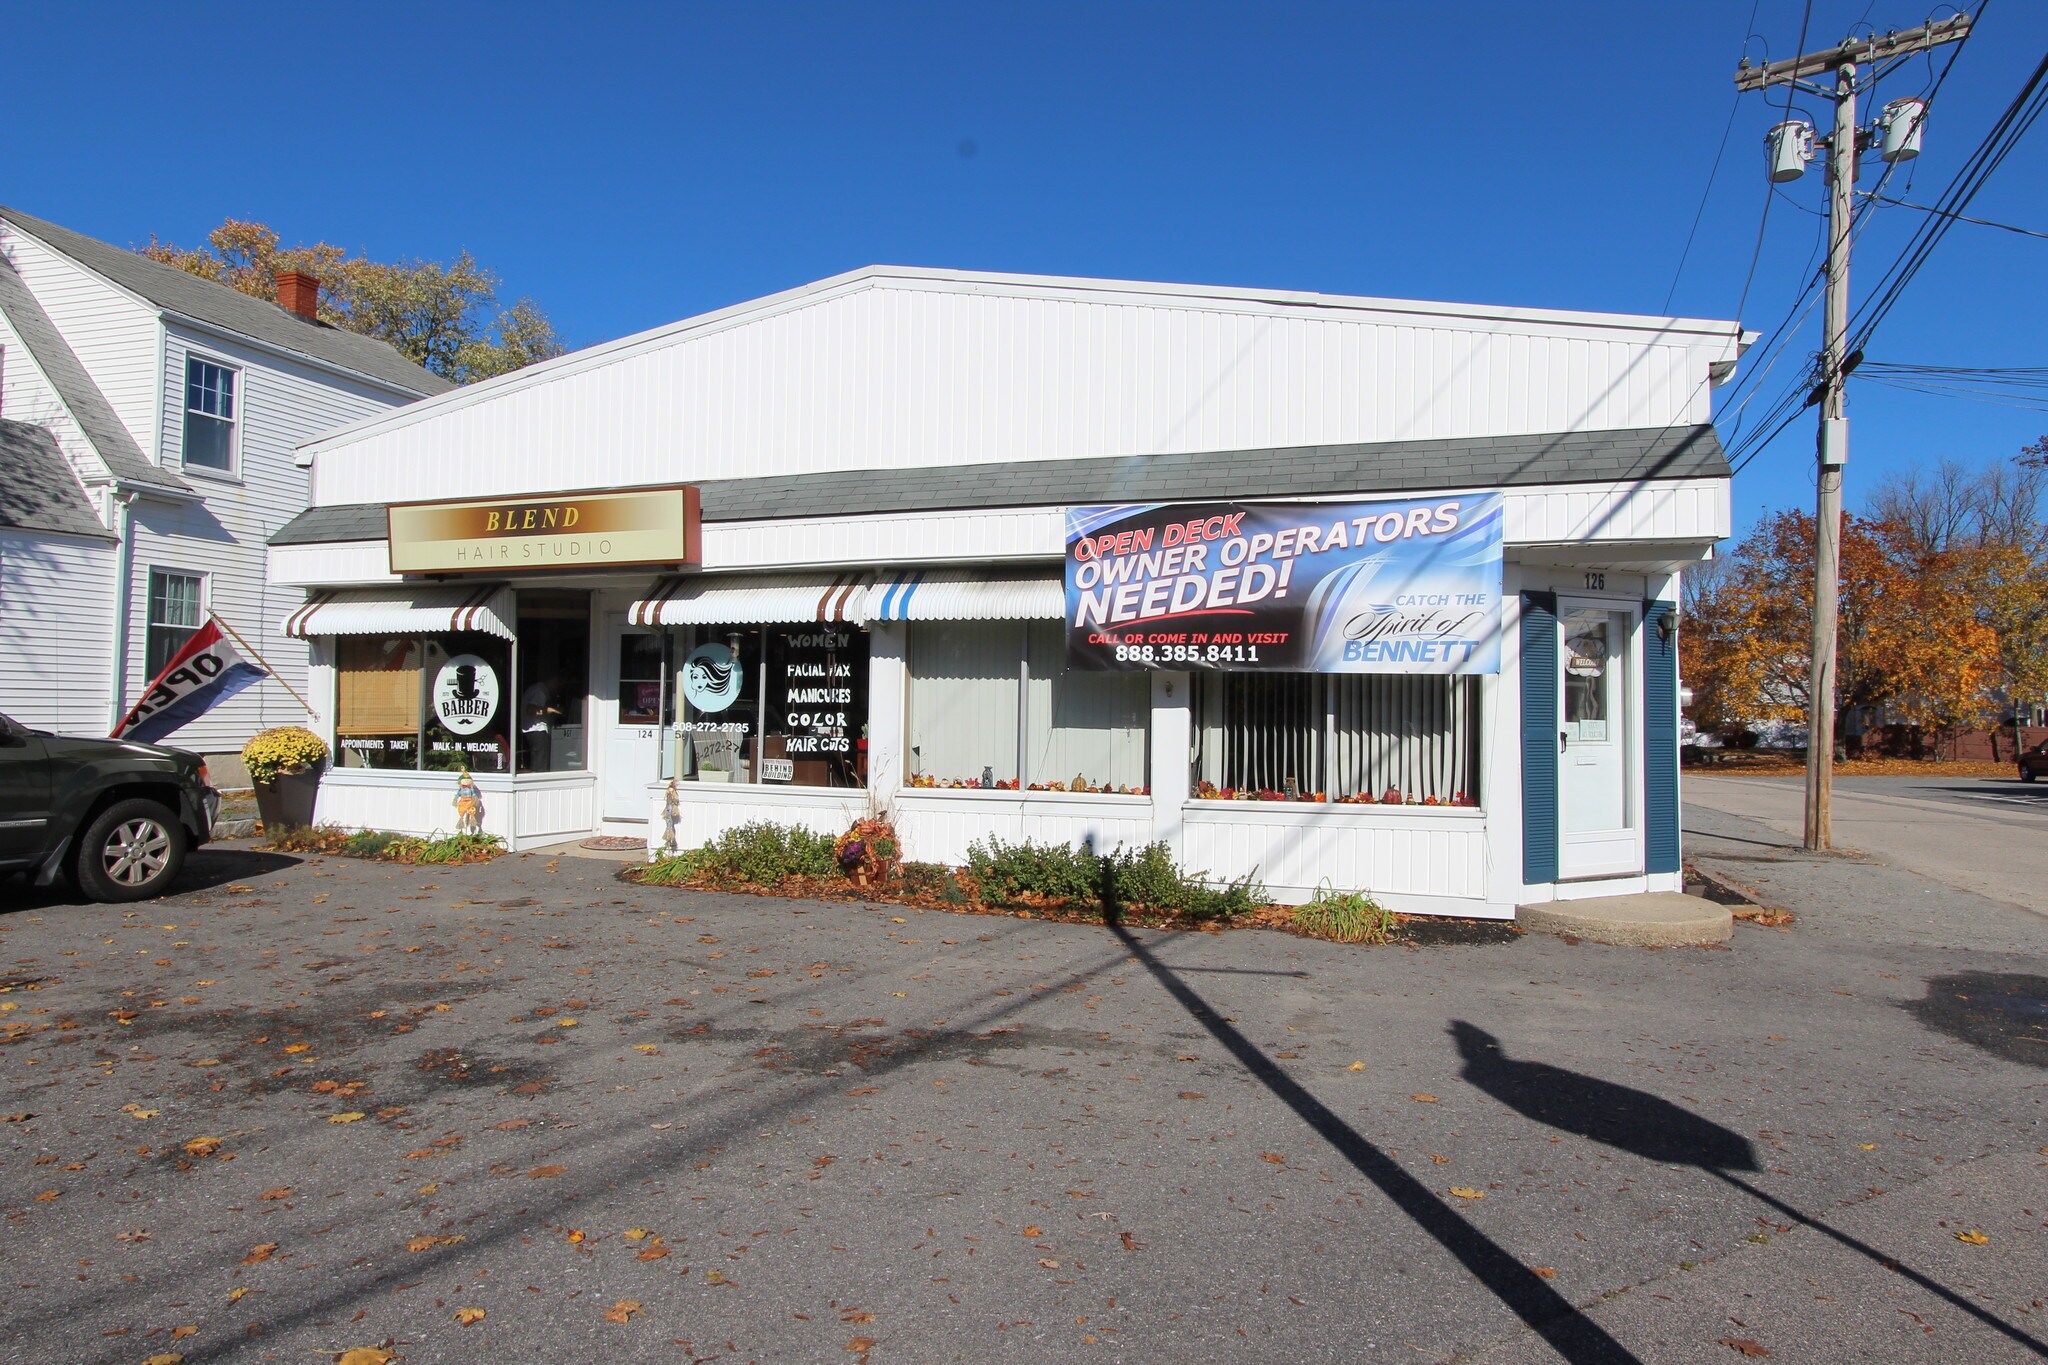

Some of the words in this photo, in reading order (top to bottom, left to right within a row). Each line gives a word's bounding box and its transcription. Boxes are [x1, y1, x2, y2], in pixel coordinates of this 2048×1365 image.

[485, 507, 579, 531] BLEND
[1074, 528, 1154, 561] OPEN
[1162, 512, 1246, 548] DECK
[457, 545, 509, 561] HAIR
[522, 540, 612, 558] STUDIO
[1075, 544, 1207, 589] OWNER
[1220, 502, 1460, 567] OPERATORS
[1585, 573, 1605, 590] 126
[1074, 559, 1294, 628] NEEDED!
[1395, 594, 1449, 606] CATCH
[1455, 593, 1487, 605] THE
[1343, 609, 1443, 649] Spirit
[1420, 611, 1485, 641] of
[787, 634, 849, 648] WOMEN
[1088, 634, 1120, 644] CALL
[1124, 634, 1143, 644] OR
[1147, 634, 1186, 644] COME
[1190, 634, 1208, 644] IN
[1211, 633, 1243, 644] AND
[1246, 633, 1289, 644] VISIT
[1115, 645, 1259, 662] 888.385.8411
[1342, 640, 1480, 662] BENNETT
[787, 663, 826, 677] FACIAL
[787, 688, 851, 703] MANICURES
[442, 699, 490, 717] BARBER
[787, 712, 848, 727] COLOR
[638, 730, 653, 738] 124
[672, 722, 749, 733] 508-272-2735
[340, 739, 384, 749] APPOINTMENTS
[389, 740, 409, 750] TAKEN
[432, 741, 450, 751] WALK
[455, 742, 462, 751] IN
[466, 742, 499, 752] WELCOME
[786, 738, 818, 752] HAIR
[764, 764, 793, 773] BEHIND
